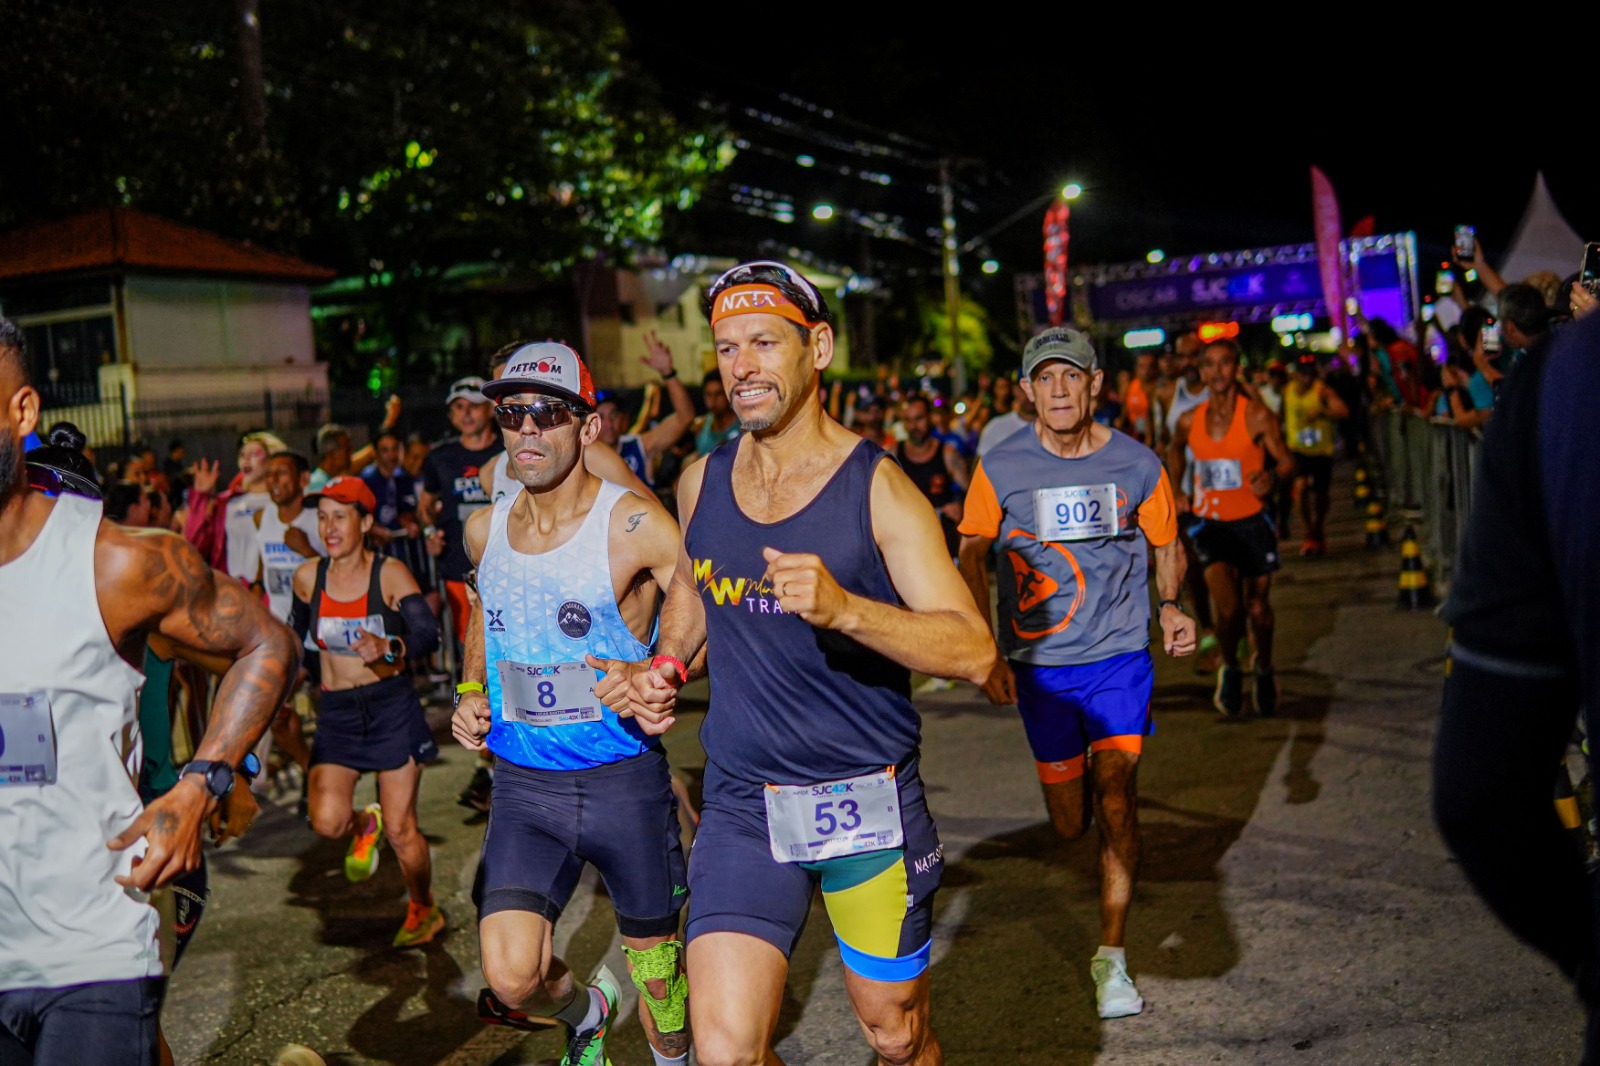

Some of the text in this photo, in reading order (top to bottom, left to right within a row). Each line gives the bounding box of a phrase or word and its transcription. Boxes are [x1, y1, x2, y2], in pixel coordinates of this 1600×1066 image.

[454, 477, 480, 492] EXT
[1055, 500, 1102, 525] 902
[746, 597, 798, 615] TRA
[527, 665, 561, 677] SJC42K
[537, 680, 557, 709] 8
[38, 734, 46, 742] B
[812, 782, 855, 797] SJC42K
[887, 805, 894, 813] B
[814, 798, 863, 836] 53
